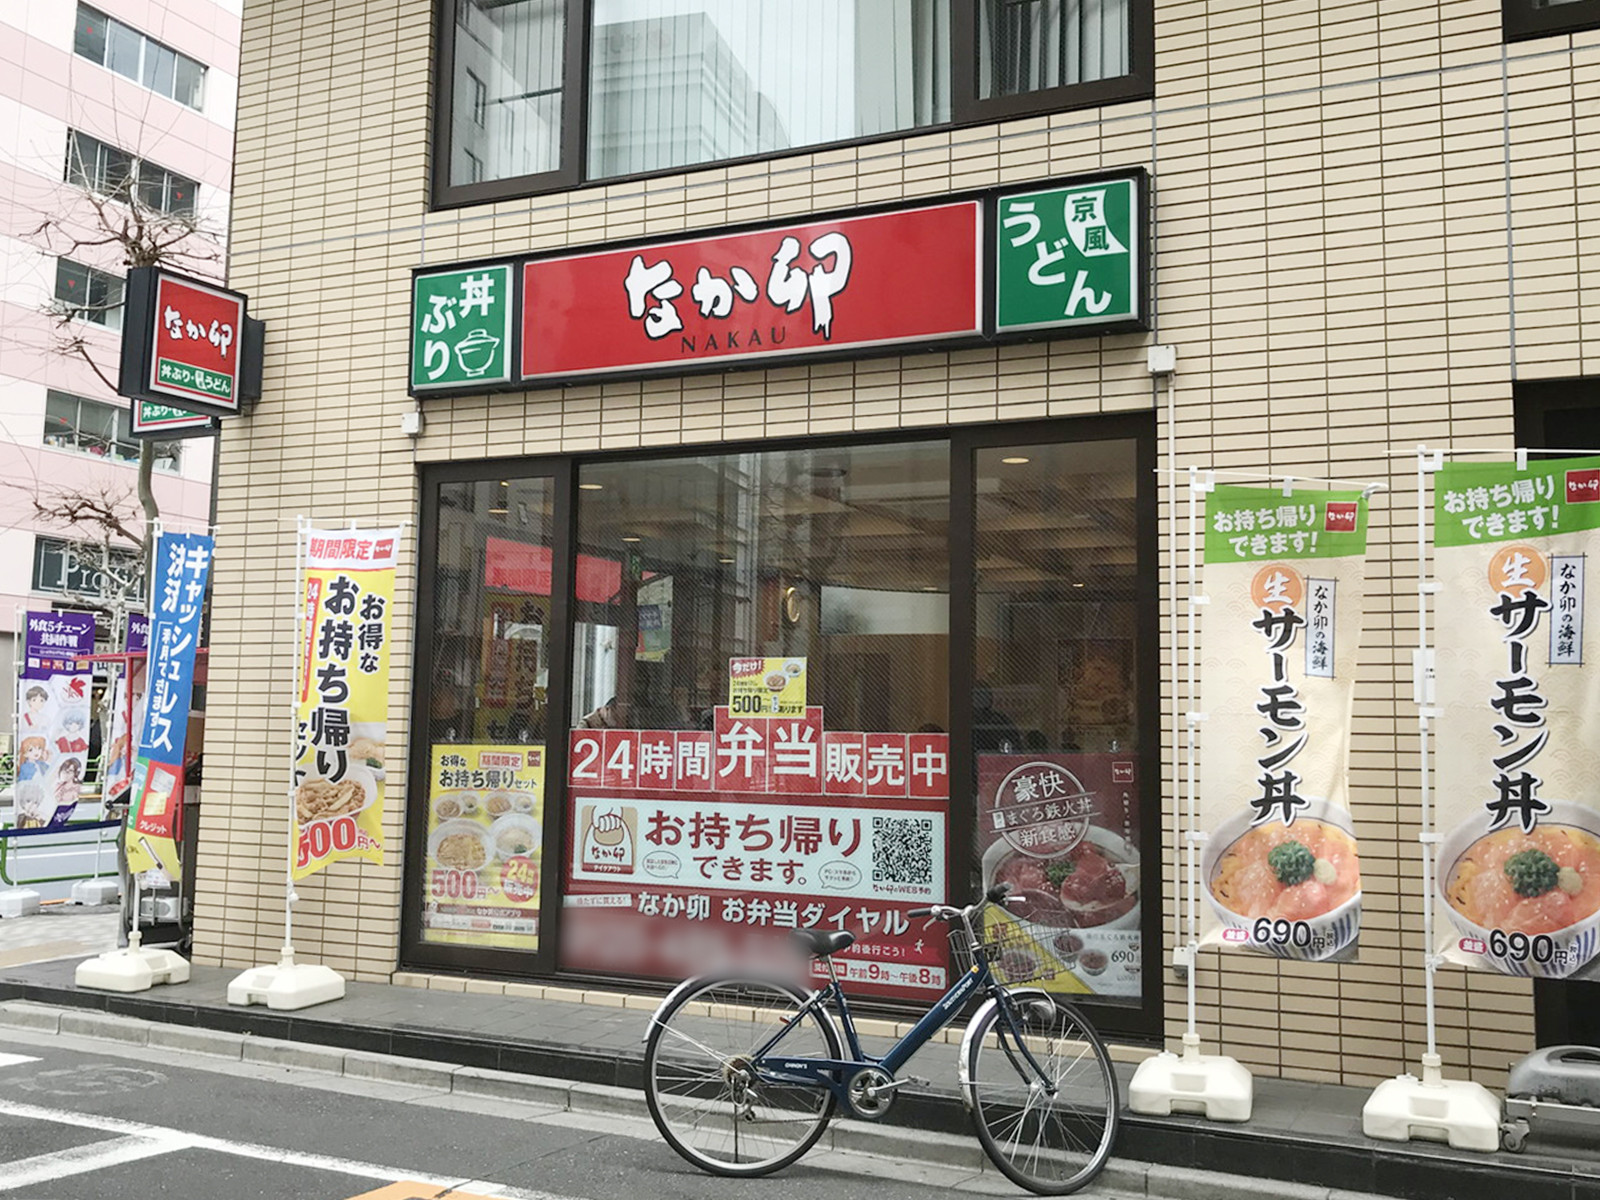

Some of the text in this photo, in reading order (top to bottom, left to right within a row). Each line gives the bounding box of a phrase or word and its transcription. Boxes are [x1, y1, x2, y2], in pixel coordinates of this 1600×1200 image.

[1070, 195, 1109, 253] 京風
[1002, 201, 1112, 317] うどん
[624, 232, 853, 340] なか卯
[164, 304, 233, 358] なか卯
[421, 273, 496, 380] 丼ぶり
[681, 326, 787, 354] NAKAU
[1444, 475, 1554, 513] お持ち帰り
[1213, 504, 1316, 533] お持ち帰り
[1462, 505, 1558, 539] できます!
[310, 538, 372, 560] 期間限定
[1229, 530, 1318, 557] できます!
[1262, 571, 1294, 605] 生
[1501, 552, 1536, 588] 生
[1312, 585, 1328, 670] なか卯の海鮮
[1557, 563, 1577, 658] なか卯の海鮮
[153, 545, 209, 752] キャッシュレス
[360, 594, 386, 673] お得な
[311, 576, 359, 783] お持ち帰り
[732, 660, 763, 674] 今だけ!
[1251, 607, 1306, 825] サーモン丼
[1488, 590, 1549, 832] サーモン丼
[441, 754, 467, 767] お得な
[571, 721, 948, 788] 24時間弁当販売中
[1011, 770, 1066, 803] 豪快
[1006, 797, 1093, 827] まぐろ鉄火丼
[592, 846, 625, 862] なか卯
[644, 809, 861, 858] お持ち帰り
[1020, 821, 1076, 848] 新食感
[693, 855, 807, 886] できます。
[637, 891, 910, 937] なか卯 お弁当ダイヤル
